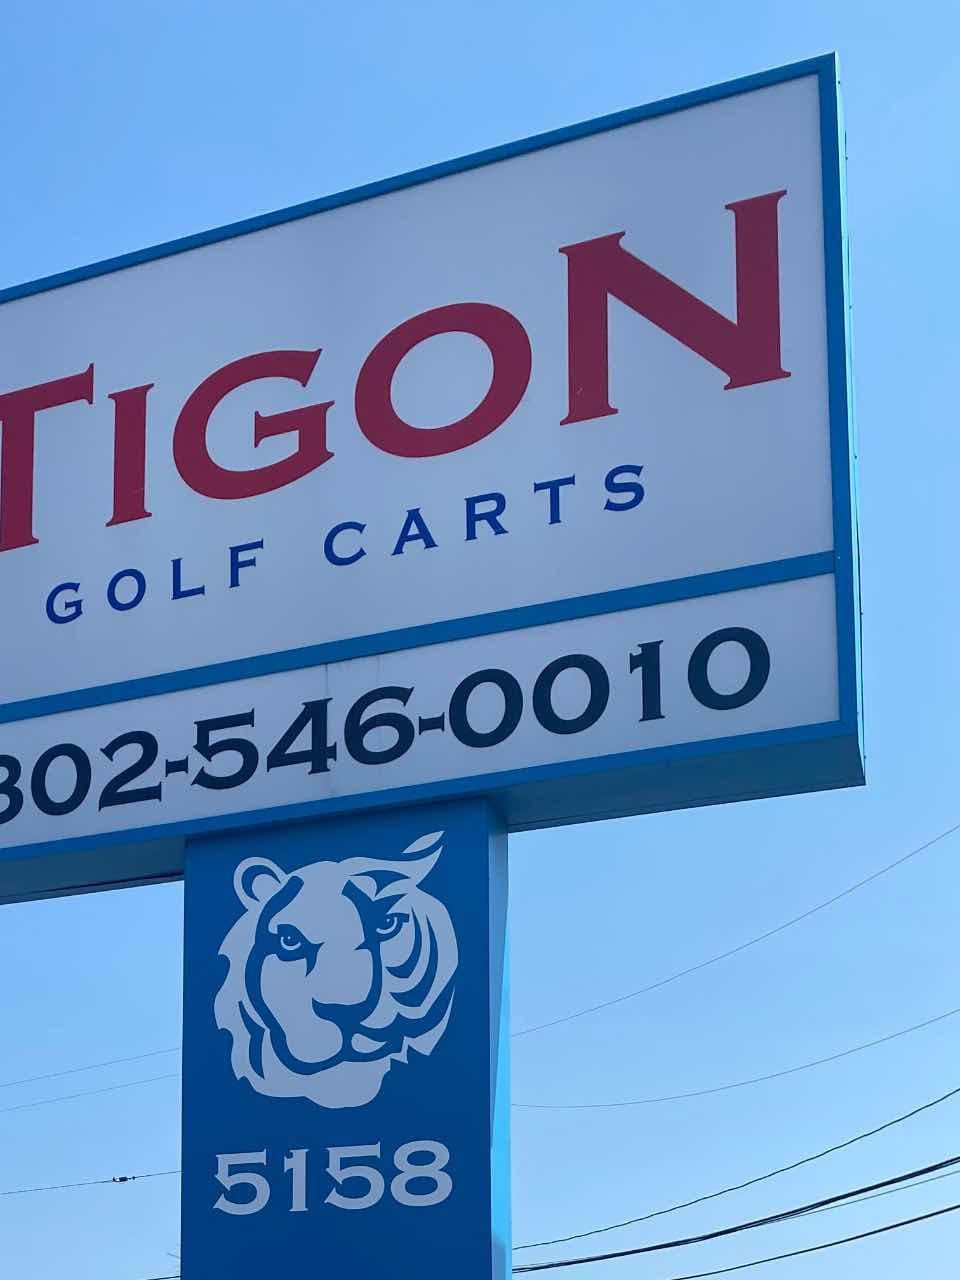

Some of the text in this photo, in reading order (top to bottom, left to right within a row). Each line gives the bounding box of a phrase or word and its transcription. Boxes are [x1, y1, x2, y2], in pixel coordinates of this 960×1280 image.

[45, 464, 646, 625] GOLF CARTS
[212, 1140, 453, 1216] 5158
